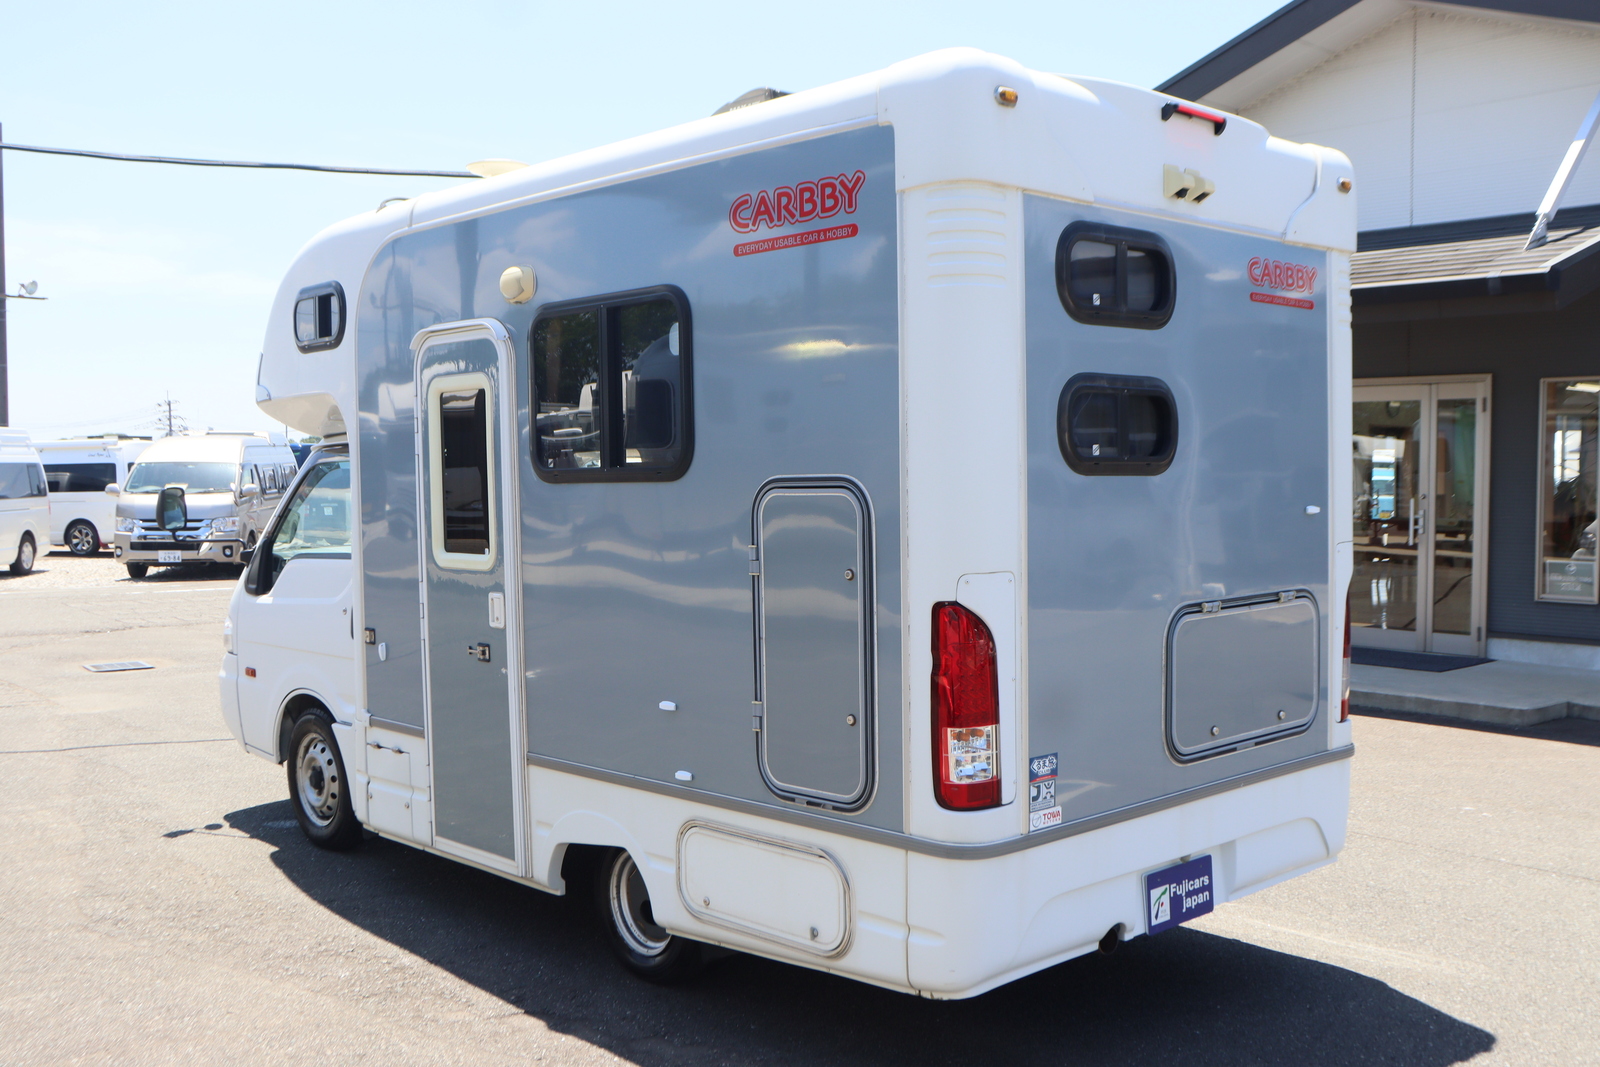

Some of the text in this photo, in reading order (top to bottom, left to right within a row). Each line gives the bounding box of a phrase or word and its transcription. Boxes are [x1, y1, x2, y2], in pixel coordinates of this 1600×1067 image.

[729, 170, 865, 234] CARBBY
[738, 226, 853, 254] EVERYDAY USABLE CAR & HOBBY
[1248, 256, 1317, 294] CARBBY
[1043, 810, 1061, 820] TOWA
[1170, 875, 1209, 897] Fujicars
[1182, 891, 1210, 913] japan
